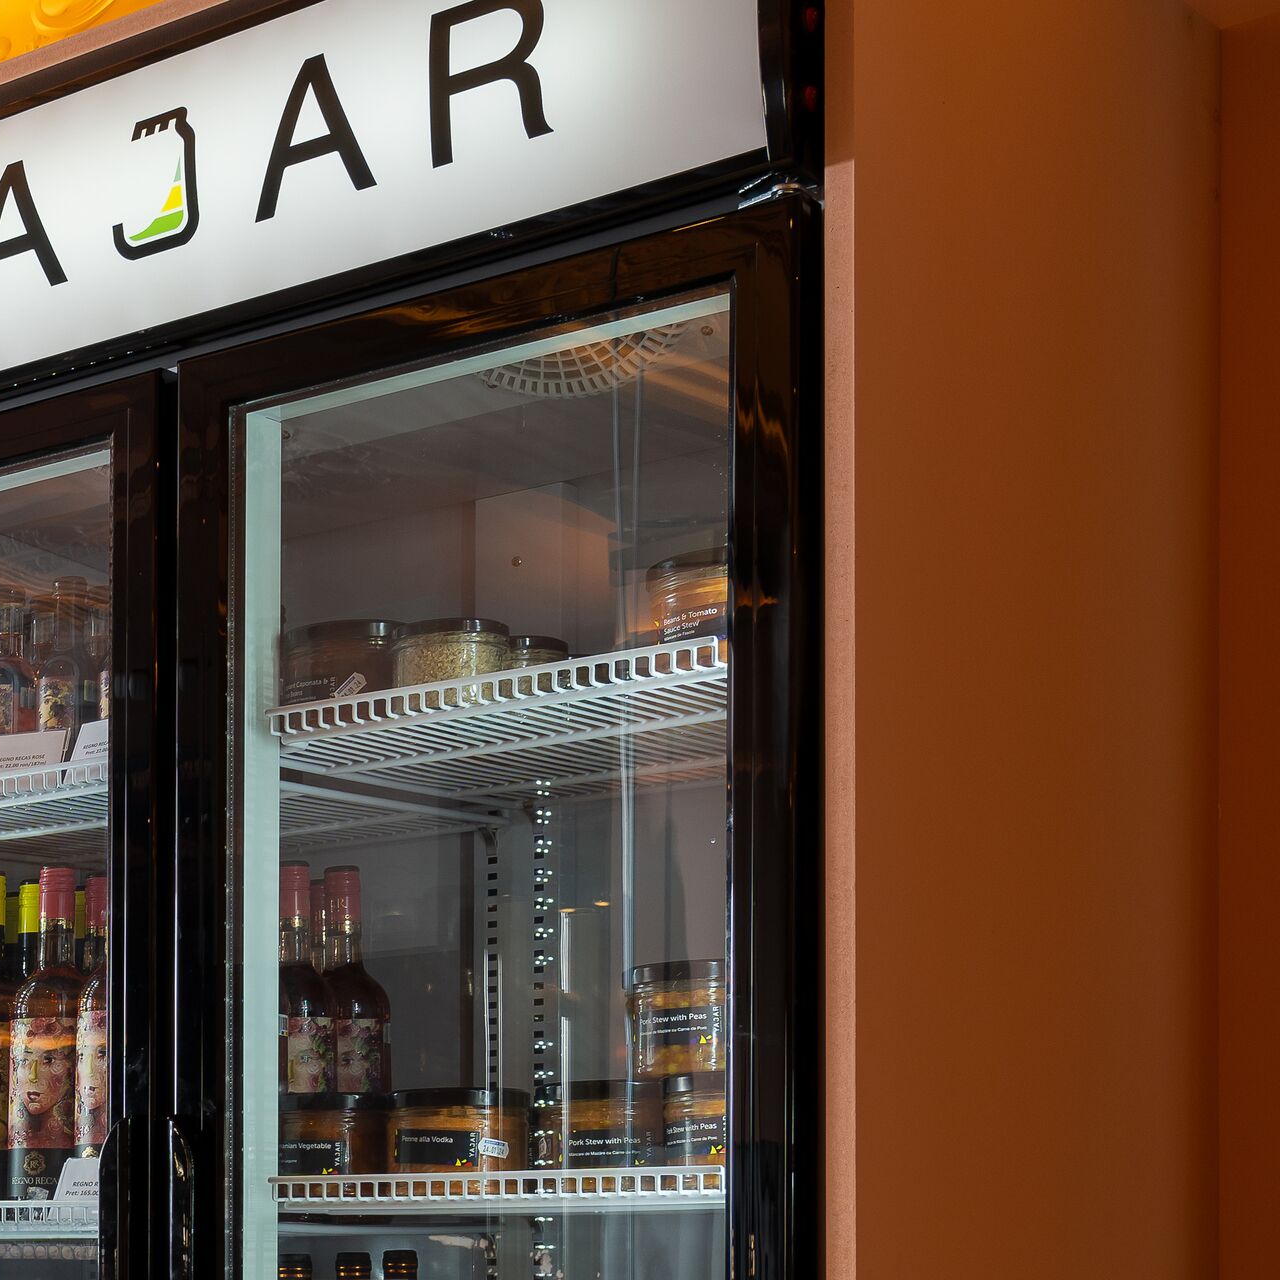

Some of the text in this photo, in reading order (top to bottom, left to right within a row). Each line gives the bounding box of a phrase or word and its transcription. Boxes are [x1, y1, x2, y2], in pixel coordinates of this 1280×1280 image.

[664, 615, 680, 626] Beans
[688, 608, 718, 618] Tomato
[664, 620, 700, 636] Sauce Stew
[652, 1016, 669, 1024] Stew
[670, 1014, 687, 1022] with
[688, 1012, 707, 1020] Peas
[700, 1122, 717, 1130] Peas
[431, 1136, 454, 1144] Vodka
[298, 1142, 332, 1150] Vegetable
[72, 1180, 94, 1188] REGNO
